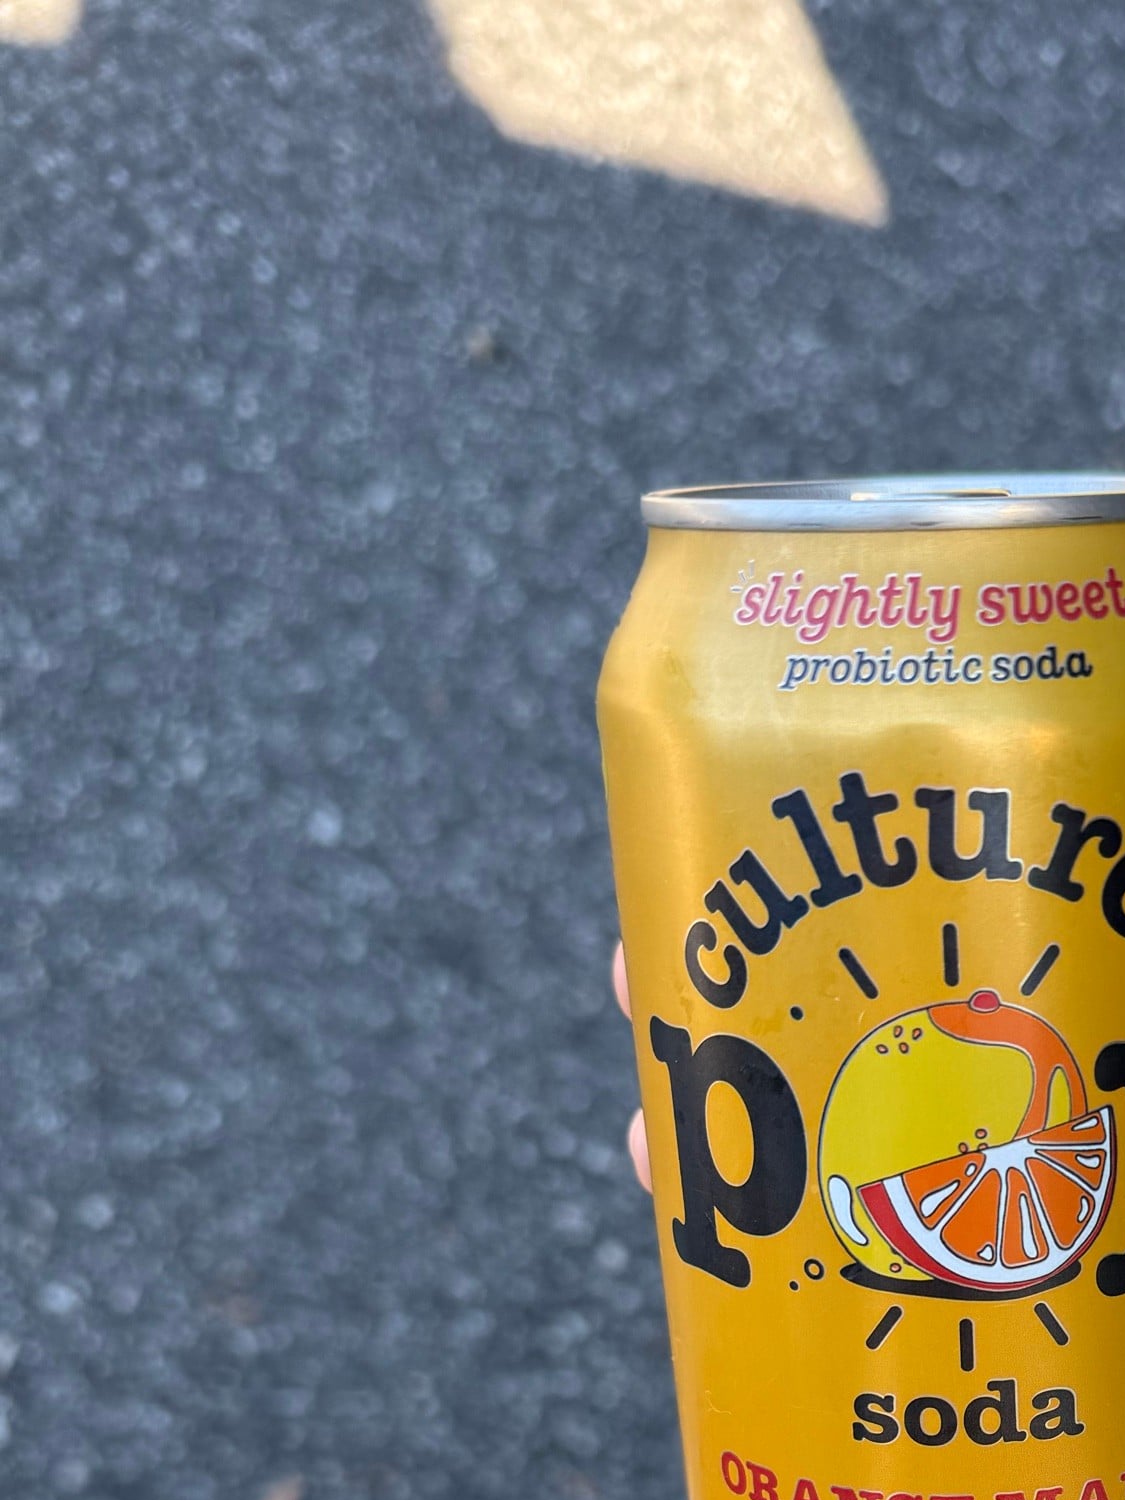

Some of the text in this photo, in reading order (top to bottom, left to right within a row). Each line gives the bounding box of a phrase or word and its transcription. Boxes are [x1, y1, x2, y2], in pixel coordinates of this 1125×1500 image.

[735, 572, 962, 643] slightly
[778, 645, 1093, 690] probiotic soda
[852, 1378, 1085, 1447] soda
